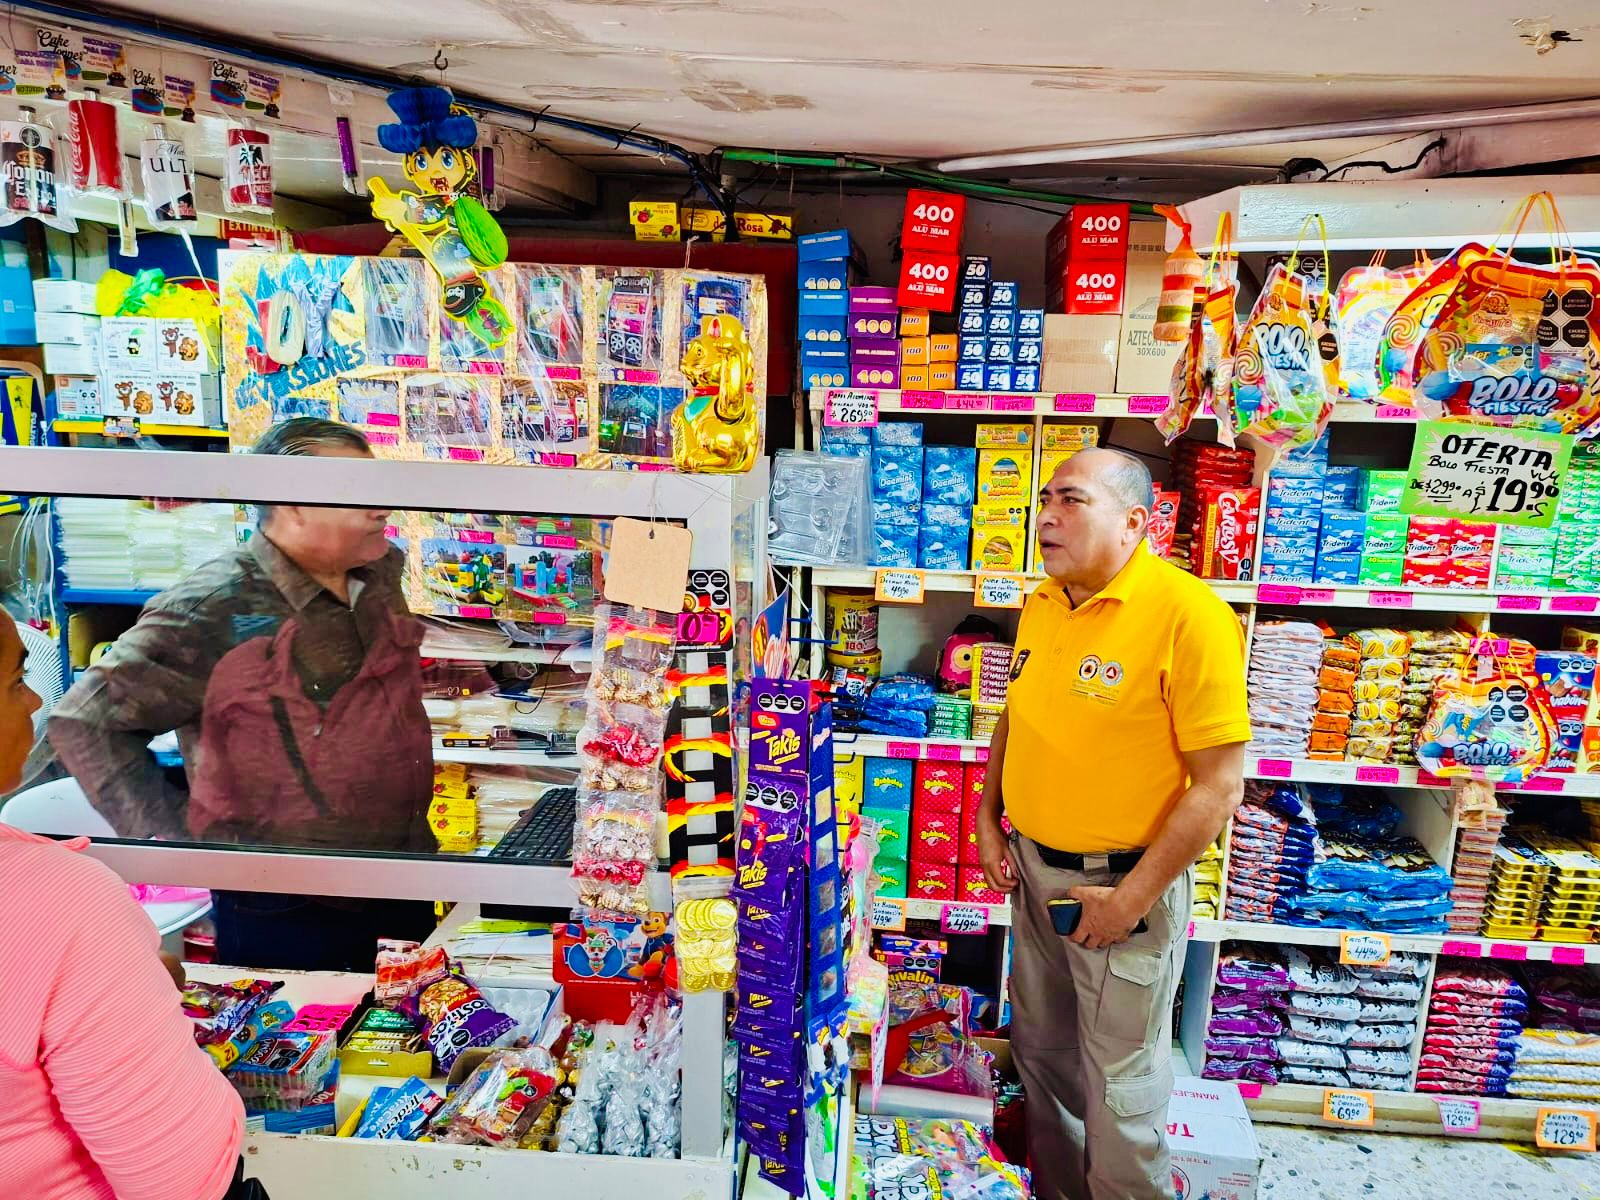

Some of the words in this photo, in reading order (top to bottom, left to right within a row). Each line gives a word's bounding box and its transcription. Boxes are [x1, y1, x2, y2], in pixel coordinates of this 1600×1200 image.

[37, 29, 69, 52] Cake
[213, 60, 238, 80] Cake
[132, 69, 156, 86] Cake
[913, 203, 955, 223] 400
[737, 217, 764, 233] Rosa
[1081, 216, 1121, 231] 400
[908, 262, 949, 281] 400
[966, 264, 986, 276] 50
[805, 278, 842, 289] 400
[1075, 273, 1116, 289] 400
[963, 292, 984, 303] 50
[991, 289, 1013, 302] 50
[854, 318, 892, 334] 400
[962, 316, 983, 329] 50
[989, 317, 1010, 330] 50
[1019, 317, 1040, 330] 50
[805, 329, 842, 341] 400
[963, 344, 983, 356] 50
[989, 344, 1010, 357] 50
[1018, 345, 1039, 358] 50
[808, 374, 845, 386] 400
[856, 369, 894, 384] 400
[960, 372, 981, 384] 50
[988, 373, 1009, 386] 50
[1015, 373, 1035, 385] 50
[1470, 376, 1558, 404] BOLO
[1441, 434, 1553, 471] OFERTA
[1464, 459, 1510, 477] FIESTA
[1279, 489, 1313, 497] Trident
[1369, 498, 1398, 506] Trident
[1365, 540, 1393, 548] Trident
[1408, 544, 1436, 552] Trident
[1452, 544, 1480, 552] Trident
[767, 733, 801, 760] Takis
[1453, 742, 1511, 761] BOLO
[738, 865, 768, 884] Takis
[311, 1089, 335, 1105] 100
[377, 1094, 422, 1139] Trident
